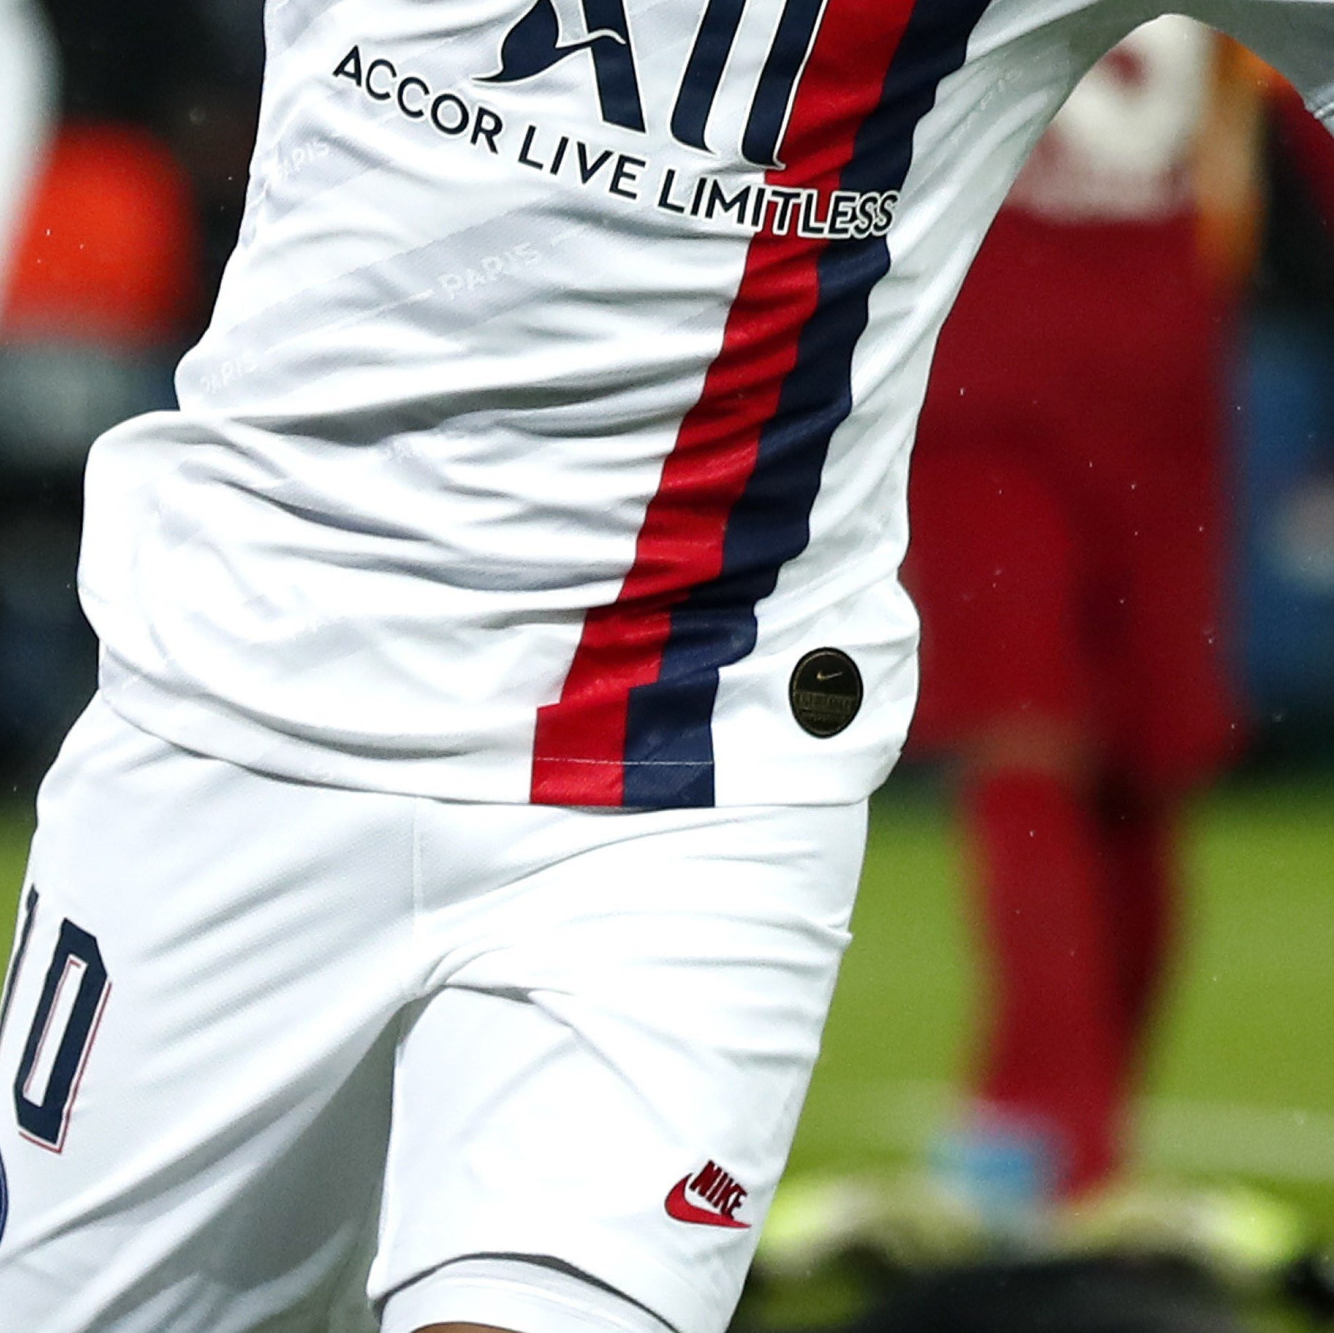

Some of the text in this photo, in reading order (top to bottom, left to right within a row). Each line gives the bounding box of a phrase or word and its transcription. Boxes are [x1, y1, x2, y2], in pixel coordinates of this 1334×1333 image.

[333, 44, 899, 238] ACCOR LIVE LIMITLESS
[689, 1160, 748, 1220] NIKE
